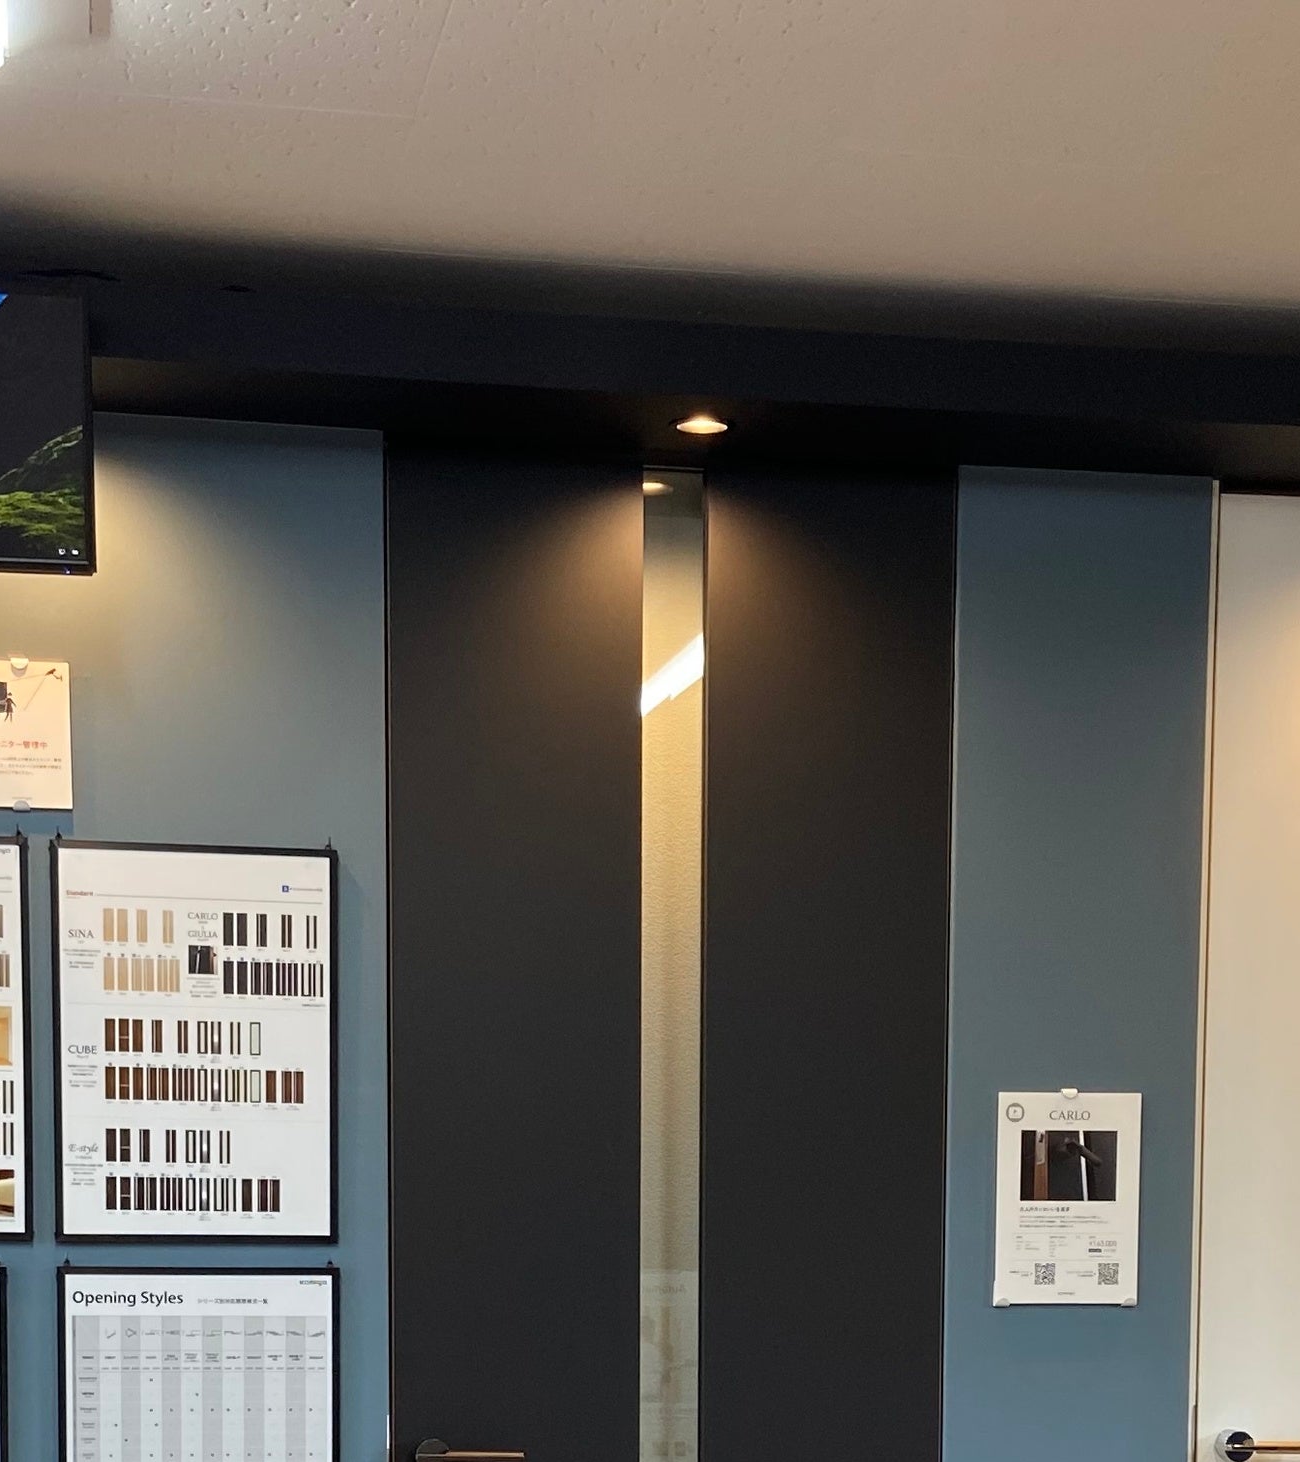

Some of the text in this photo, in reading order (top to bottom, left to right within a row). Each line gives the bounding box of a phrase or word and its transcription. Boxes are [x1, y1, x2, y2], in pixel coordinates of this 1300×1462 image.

[187, 912, 219, 920] CARLO
[68, 928, 95, 939] SINA
[67, 1044, 98, 1055] CUBE
[1049, 1109, 1091, 1121] CARLO
[72, 1290, 137, 1308] Opening
[140, 1290, 185, 1307] Styles
